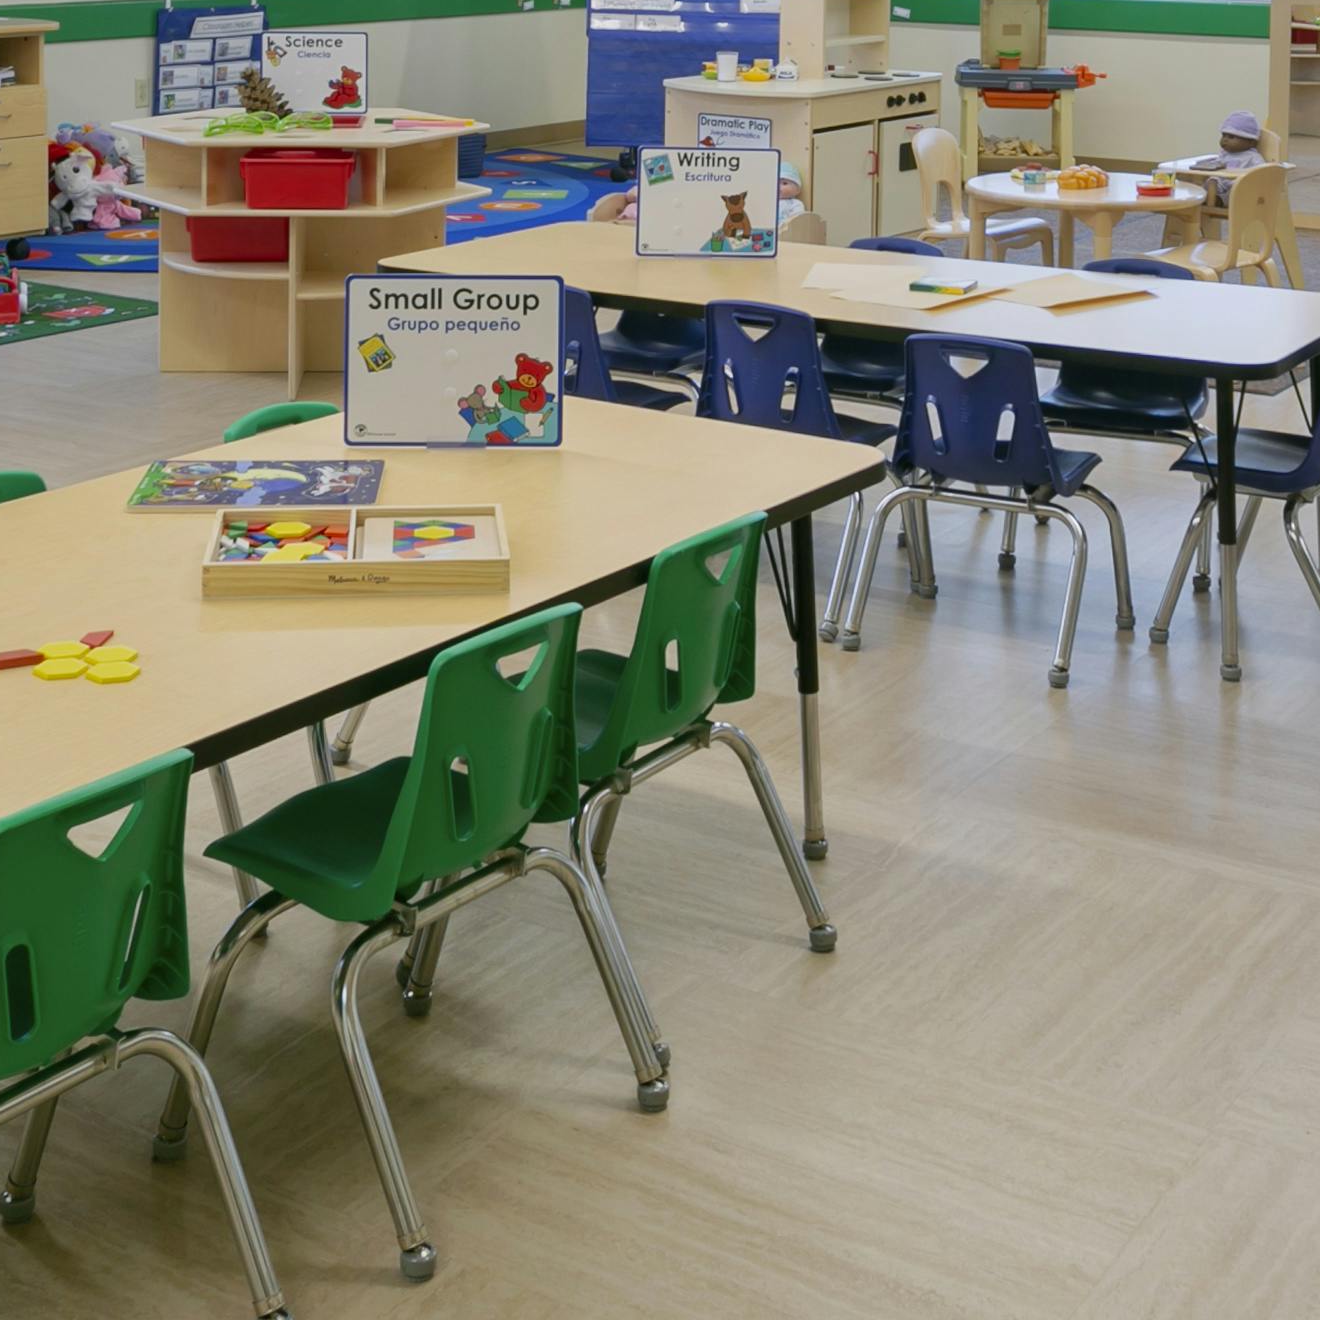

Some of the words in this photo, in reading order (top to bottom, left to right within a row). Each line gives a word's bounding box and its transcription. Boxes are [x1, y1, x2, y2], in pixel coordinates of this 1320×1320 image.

[285, 35, 344, 49] Science
[297, 50, 331, 59] Ciencia
[701, 116, 746, 130] Dramatic
[748, 120, 770, 133] Play
[677, 152, 741, 171] Writing
[685, 171, 732, 182] Escritura
[368, 287, 443, 311] Small
[452, 287, 540, 316] Group
[387, 316, 440, 333] Grupo
[444, 316, 521, 333] pequeño
